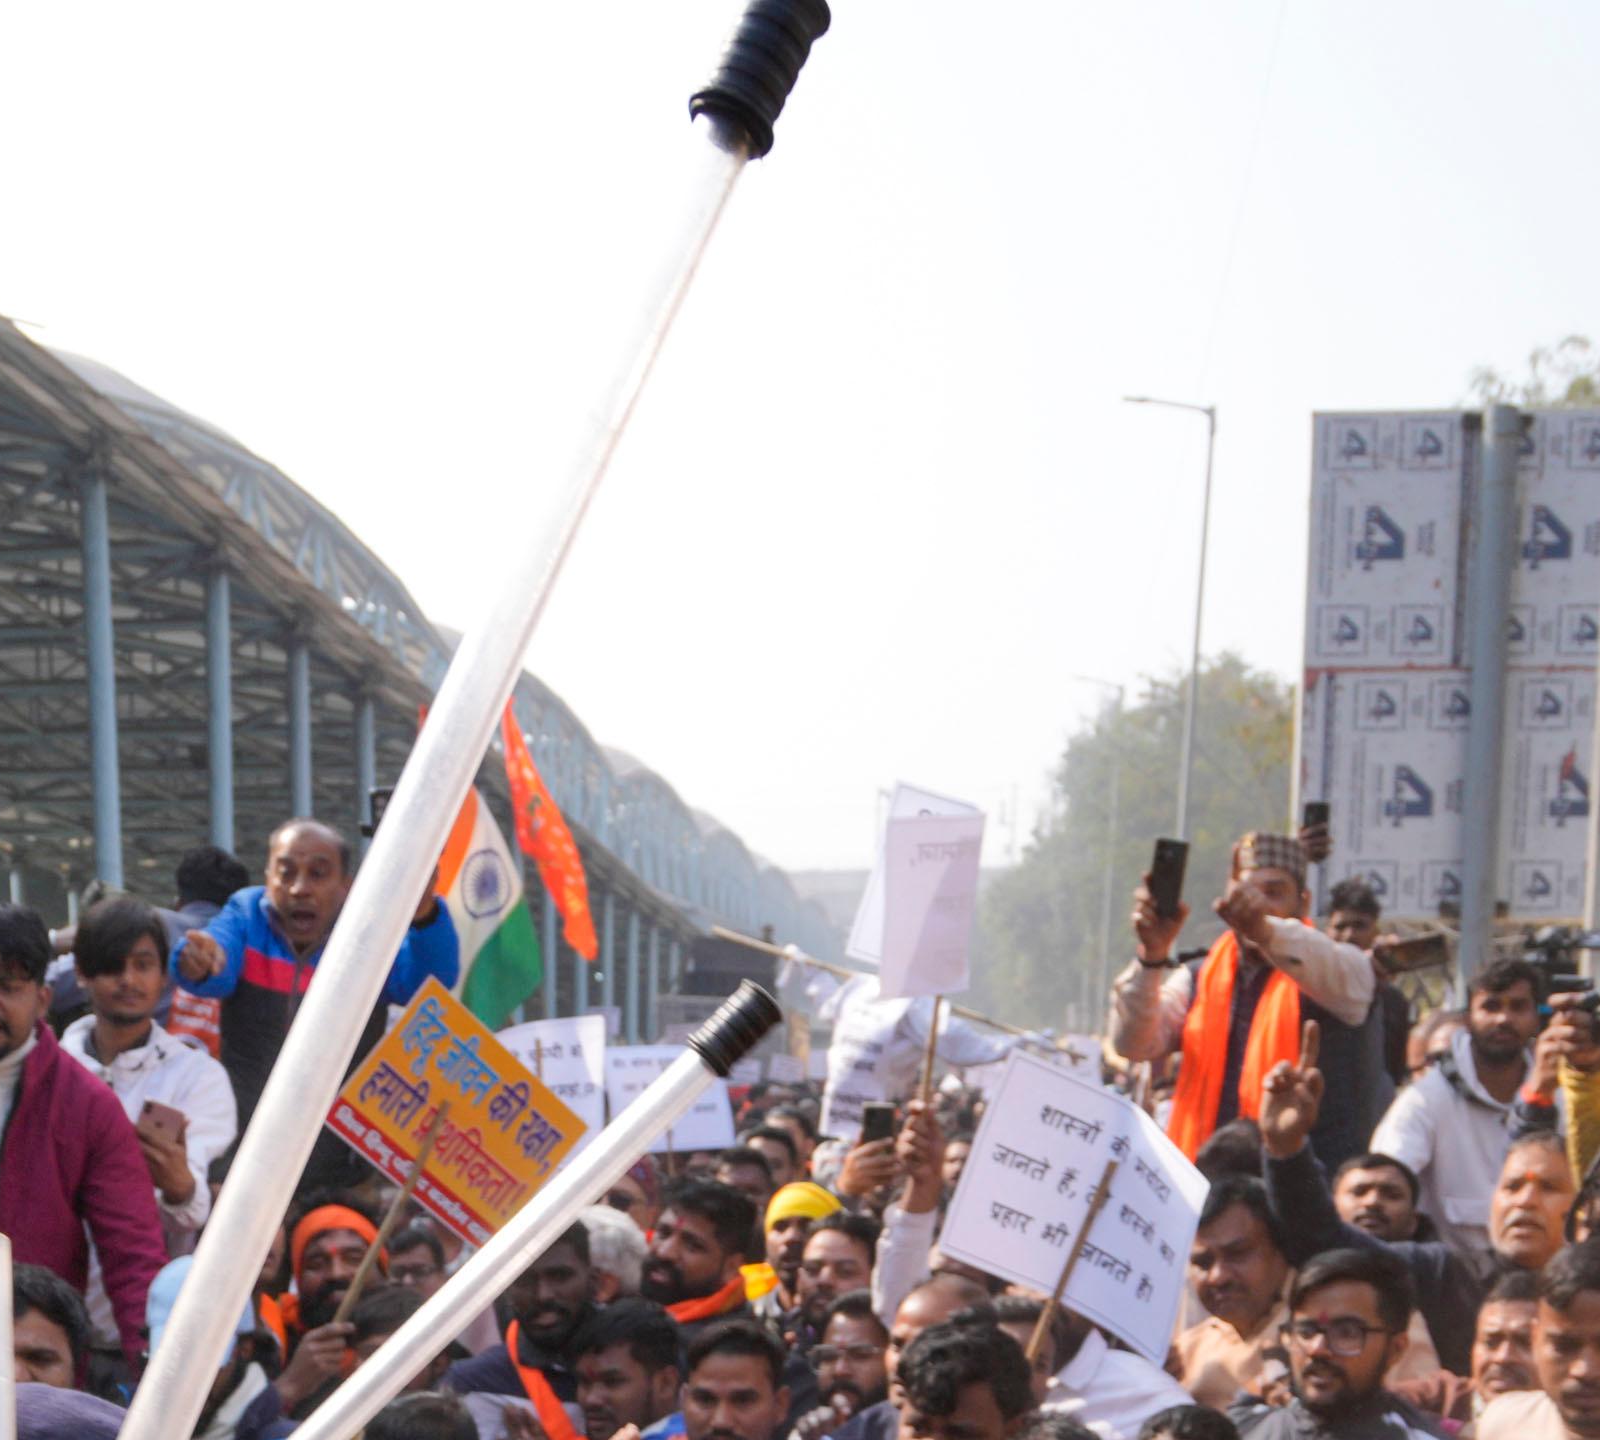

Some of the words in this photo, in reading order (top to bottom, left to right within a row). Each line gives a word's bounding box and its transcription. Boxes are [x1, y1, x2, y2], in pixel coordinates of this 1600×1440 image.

[400, 997, 449, 1076] हिंदू
[434, 1033, 500, 1105] जीवन
[489, 1079, 531, 1131] की
[361, 1060, 430, 1130] हमारी
[410, 1107, 526, 1215] प्रथमिकता!
[992, 1143, 1050, 1180] जानते
[991, 1201, 1033, 1233] प्रहार
[1041, 1223, 1069, 1248] भी
